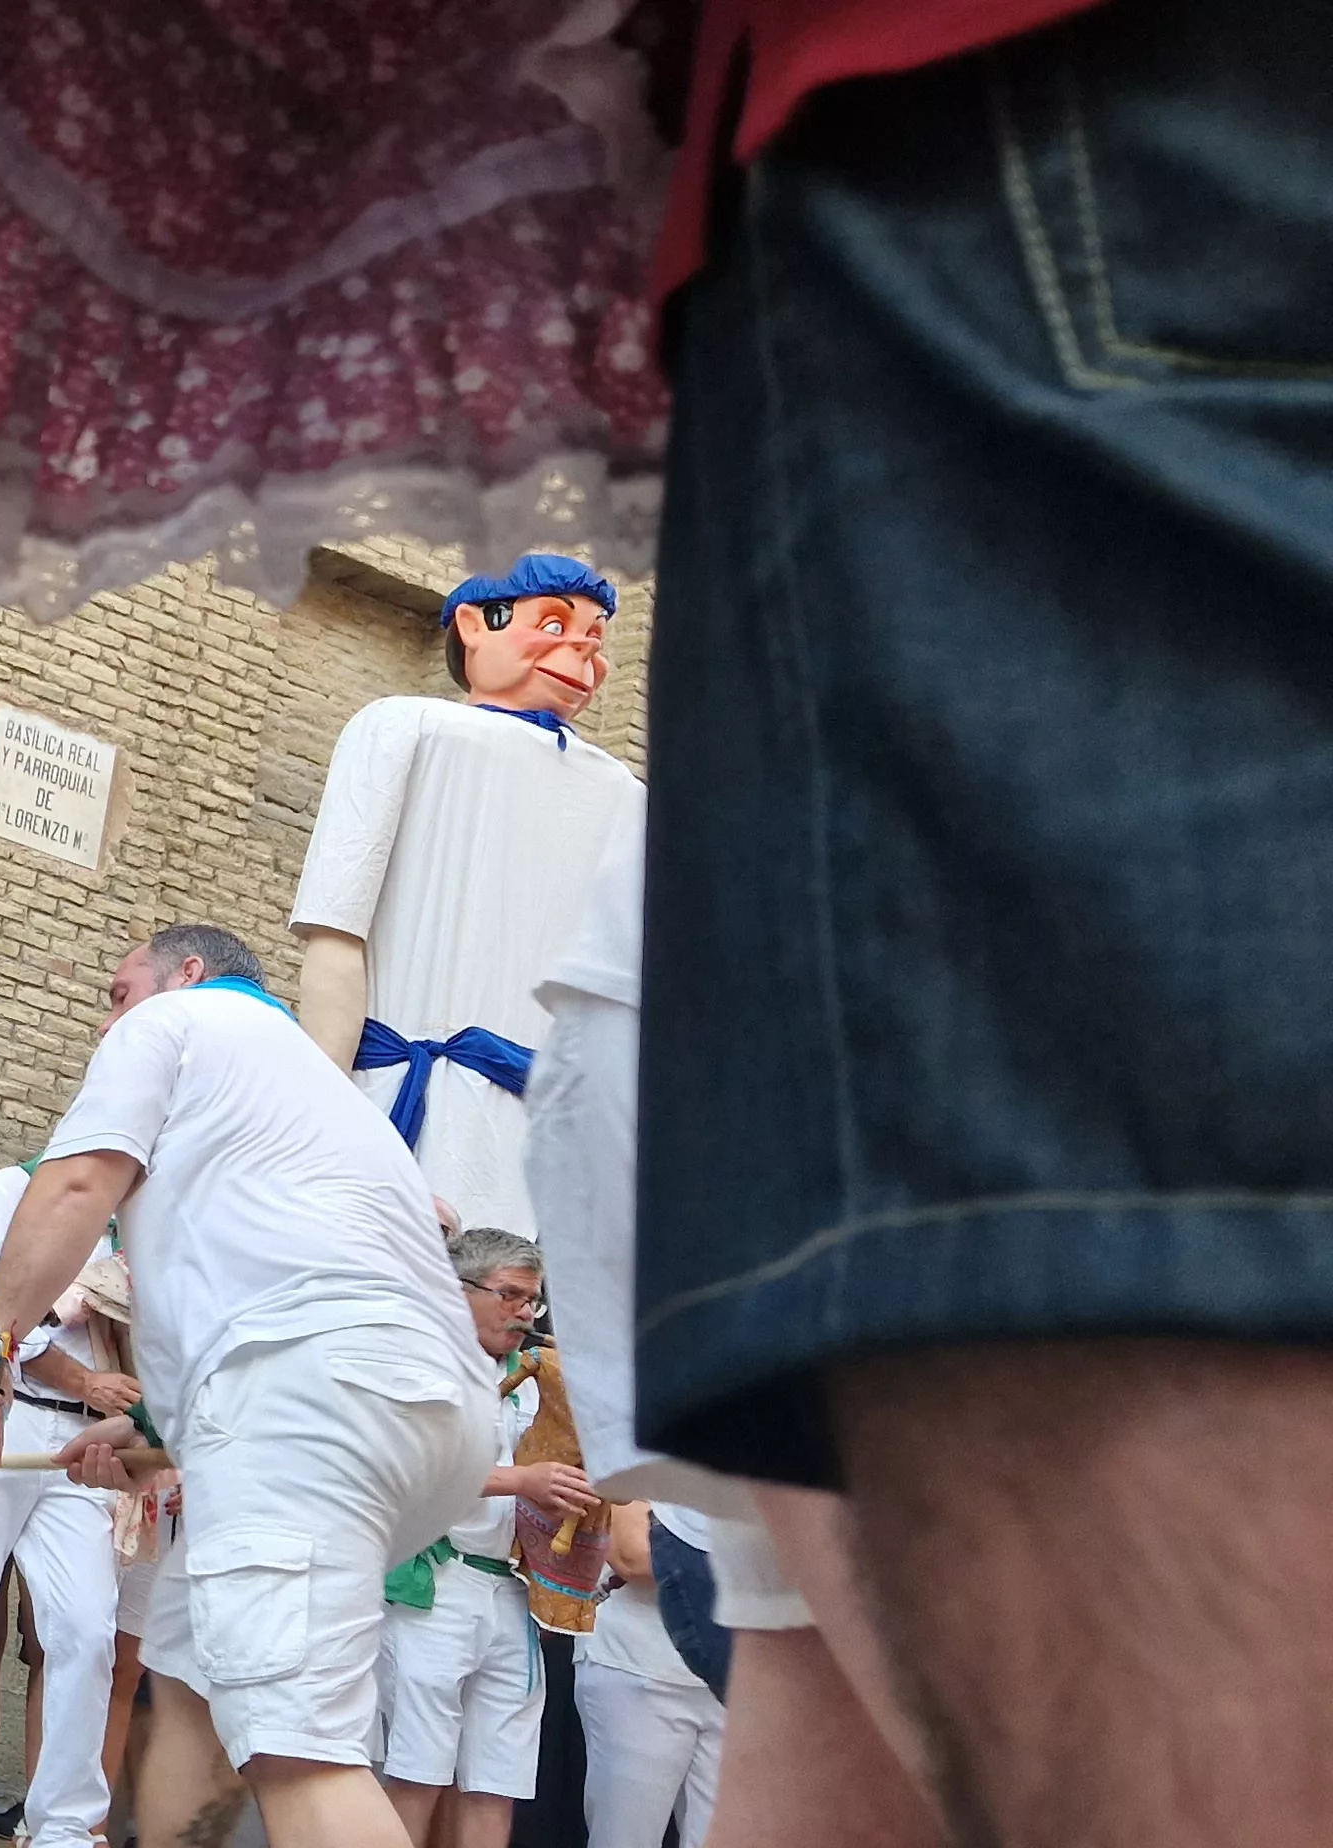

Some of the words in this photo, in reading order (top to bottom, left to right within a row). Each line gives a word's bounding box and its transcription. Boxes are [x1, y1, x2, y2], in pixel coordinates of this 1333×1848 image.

[2, 745, 10, 766] Y
[14, 751, 96, 799] PARROQUIAL
[68, 743, 101, 774] REAL
[35, 787, 55, 811] DE
